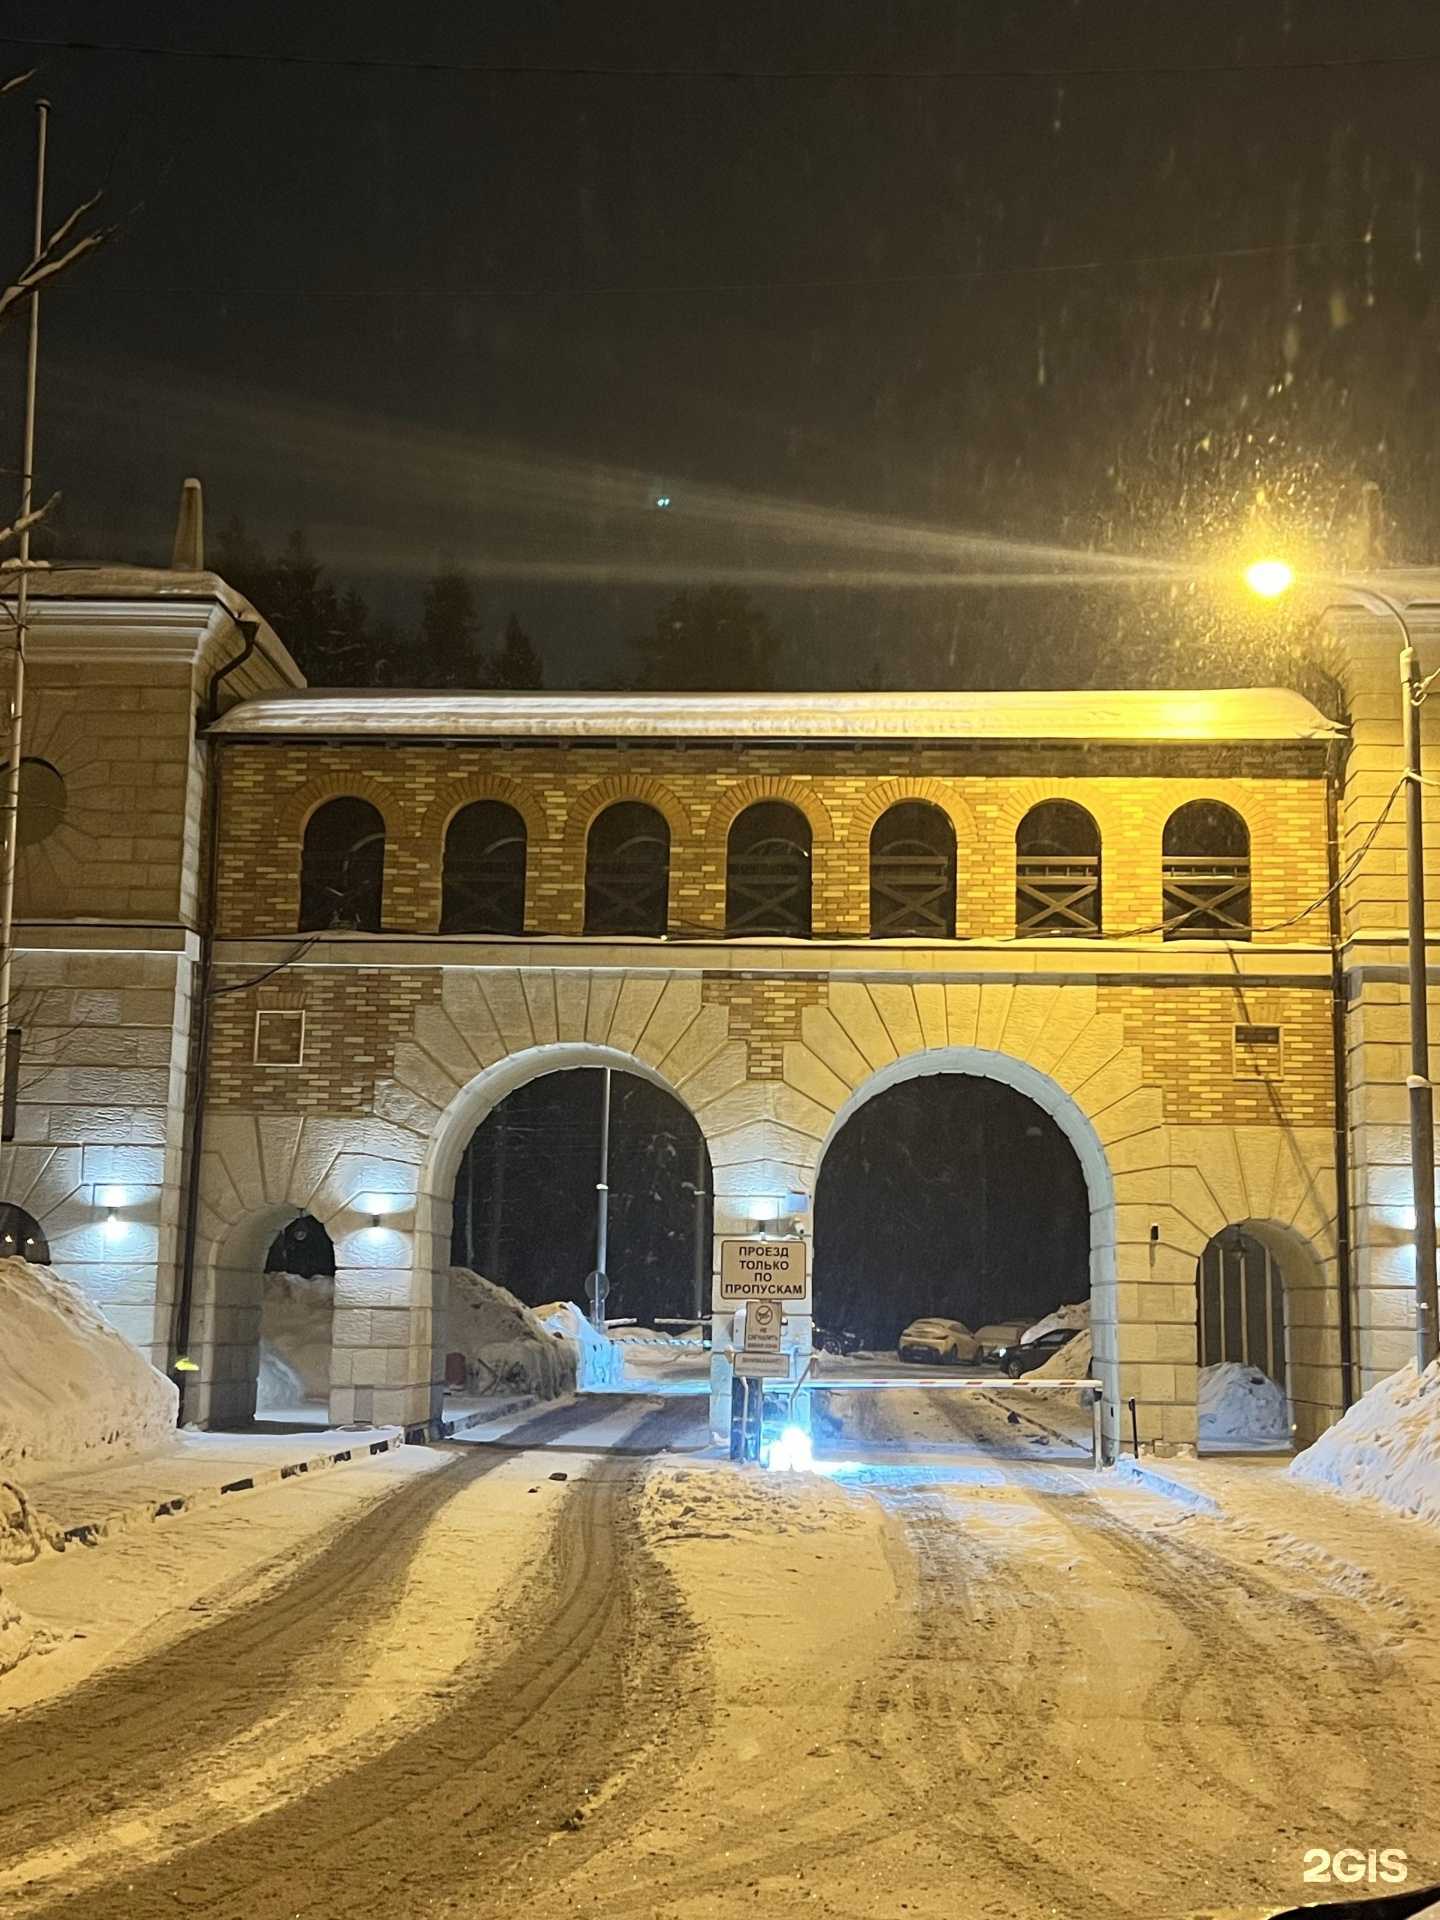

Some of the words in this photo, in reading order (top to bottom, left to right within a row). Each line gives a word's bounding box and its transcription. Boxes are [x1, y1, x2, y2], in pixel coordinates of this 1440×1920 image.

[739, 1246, 789, 1258] ПРОЕЗД
[739, 1260, 789, 1270] ТОЛЬКО
[754, 1272, 772, 1282] ПО
[725, 1284, 803, 1294] ПРОПУСКАМ
